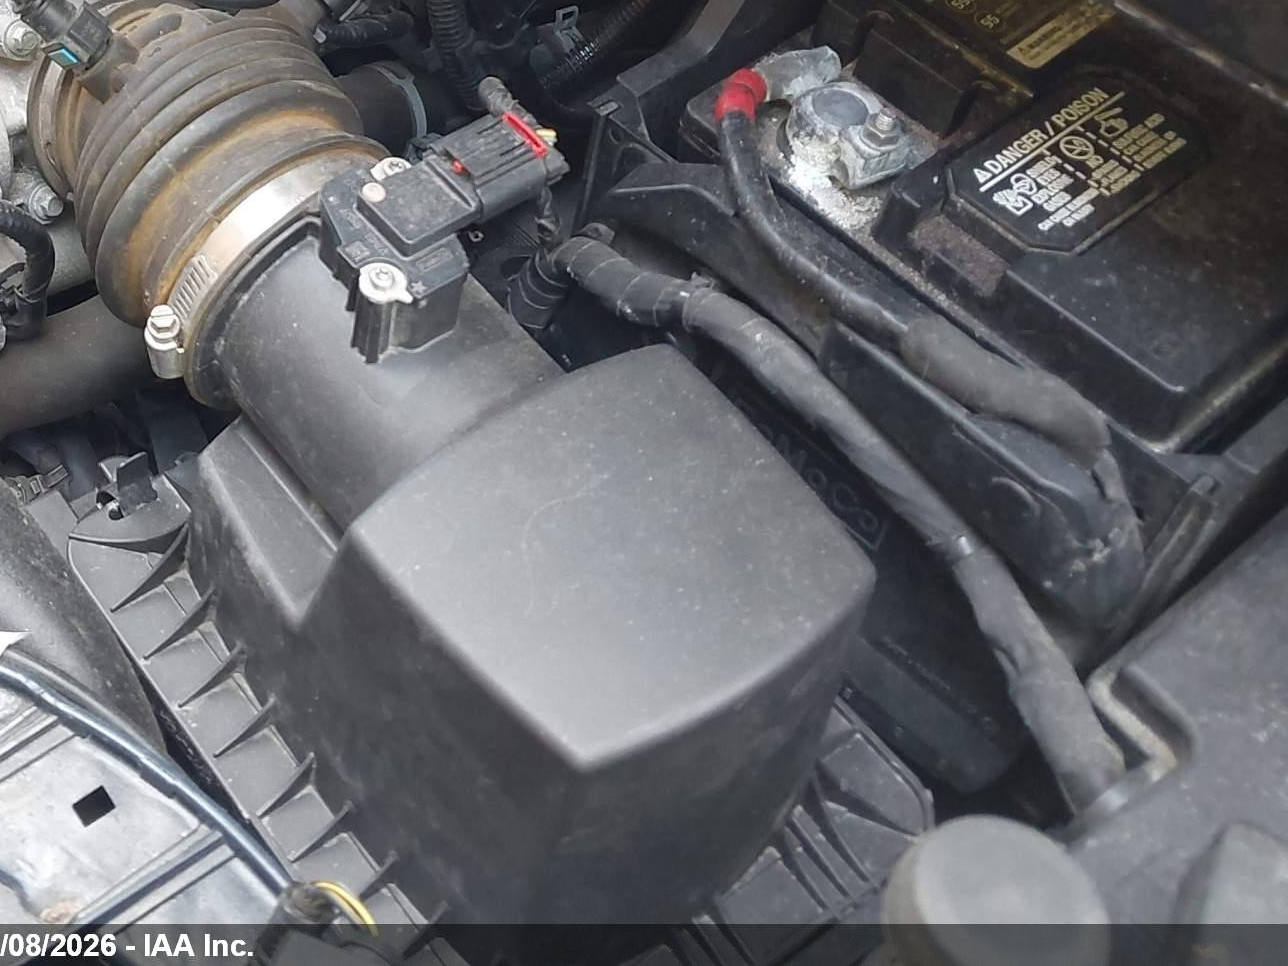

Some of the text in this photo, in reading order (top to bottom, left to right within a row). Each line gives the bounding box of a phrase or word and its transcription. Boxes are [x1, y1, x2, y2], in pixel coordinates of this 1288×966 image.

[983, 129, 1049, 174] DANGER
[1051, 87, 1110, 127] POISON
[1086, 155, 1104, 169] NO
